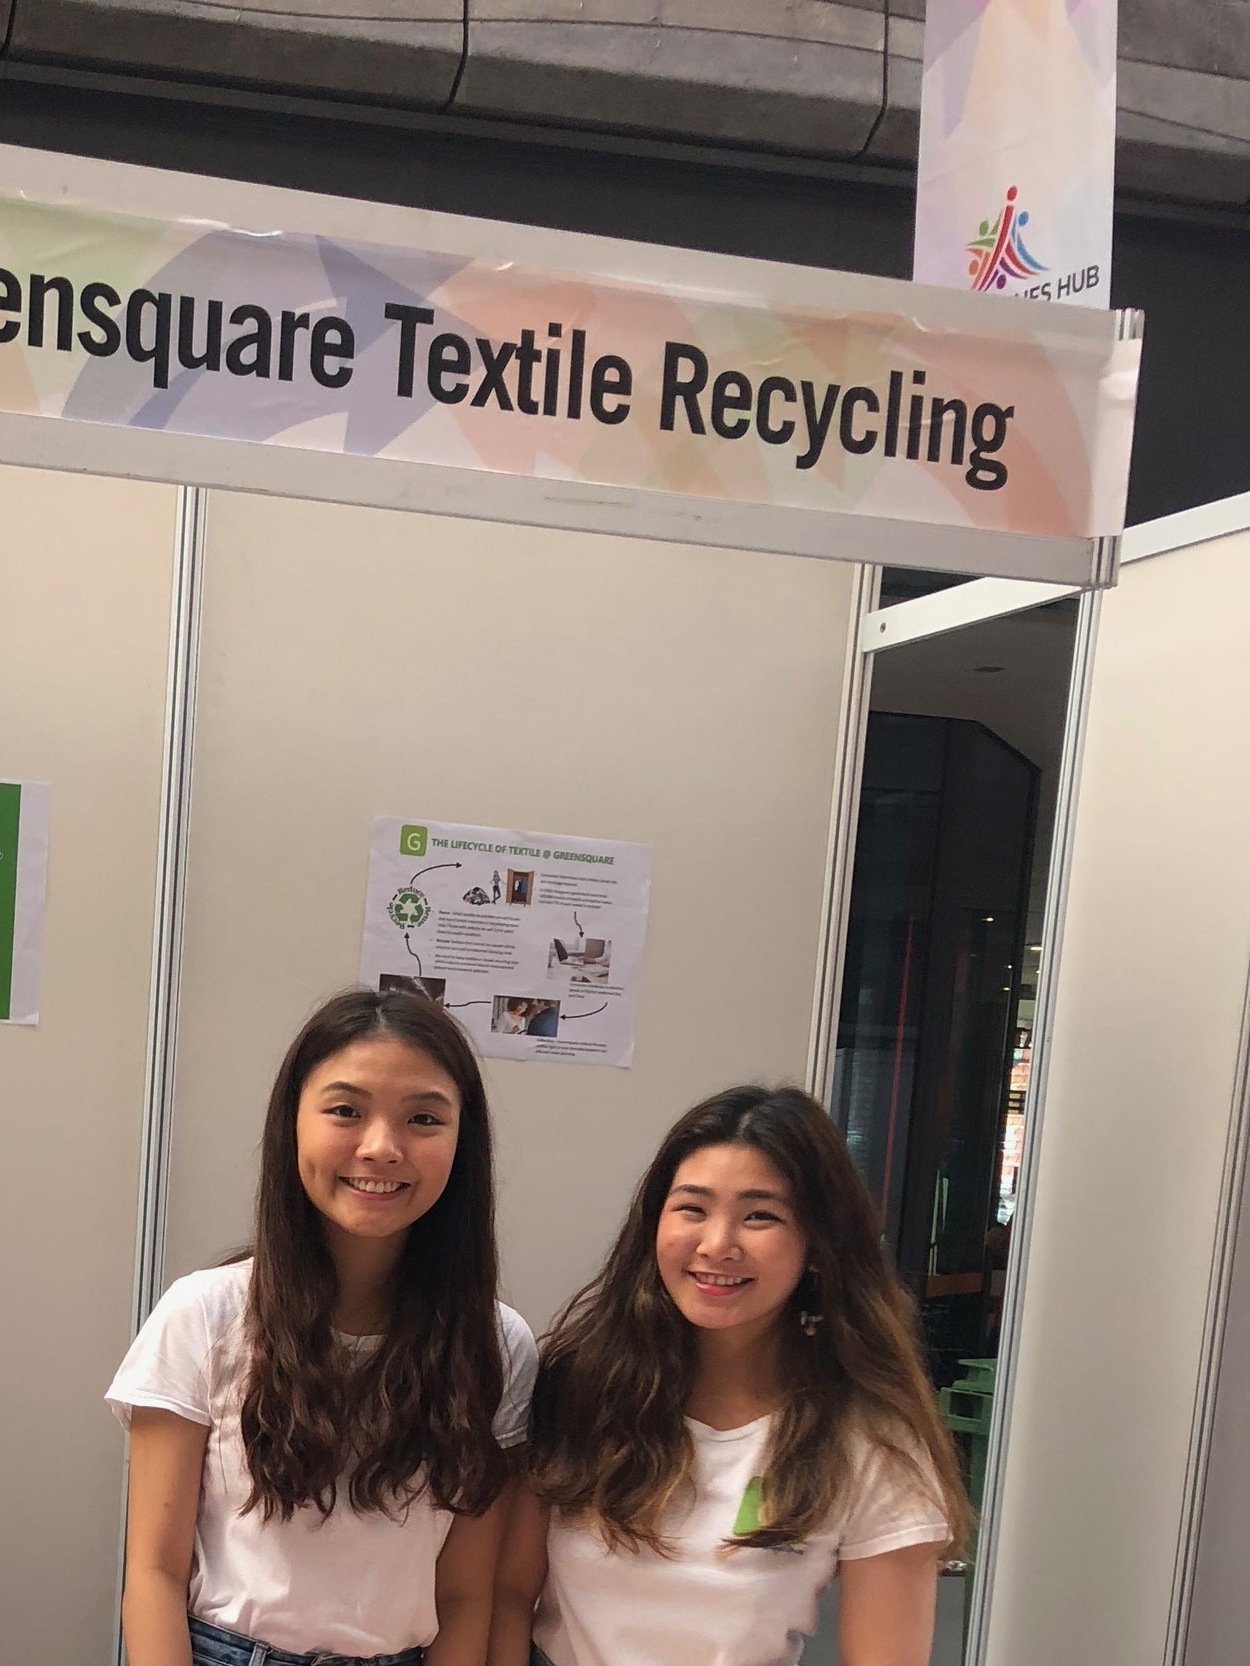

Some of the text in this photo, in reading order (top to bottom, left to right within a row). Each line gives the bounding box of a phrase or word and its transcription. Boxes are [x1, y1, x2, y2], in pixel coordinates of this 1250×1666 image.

[1058, 265, 1100, 300] HUB
[384, 302, 633, 425] Textile
[659, 341, 1015, 491] Recycling
[432, 838, 449, 848] THE
[451, 840, 493, 852] LIFECYCLE
[495, 844, 506, 853] OF
[508, 846, 541, 857] TEXTILE
[543, 849, 551, 859] @
[553, 850, 614, 865] GREENSQUARE
